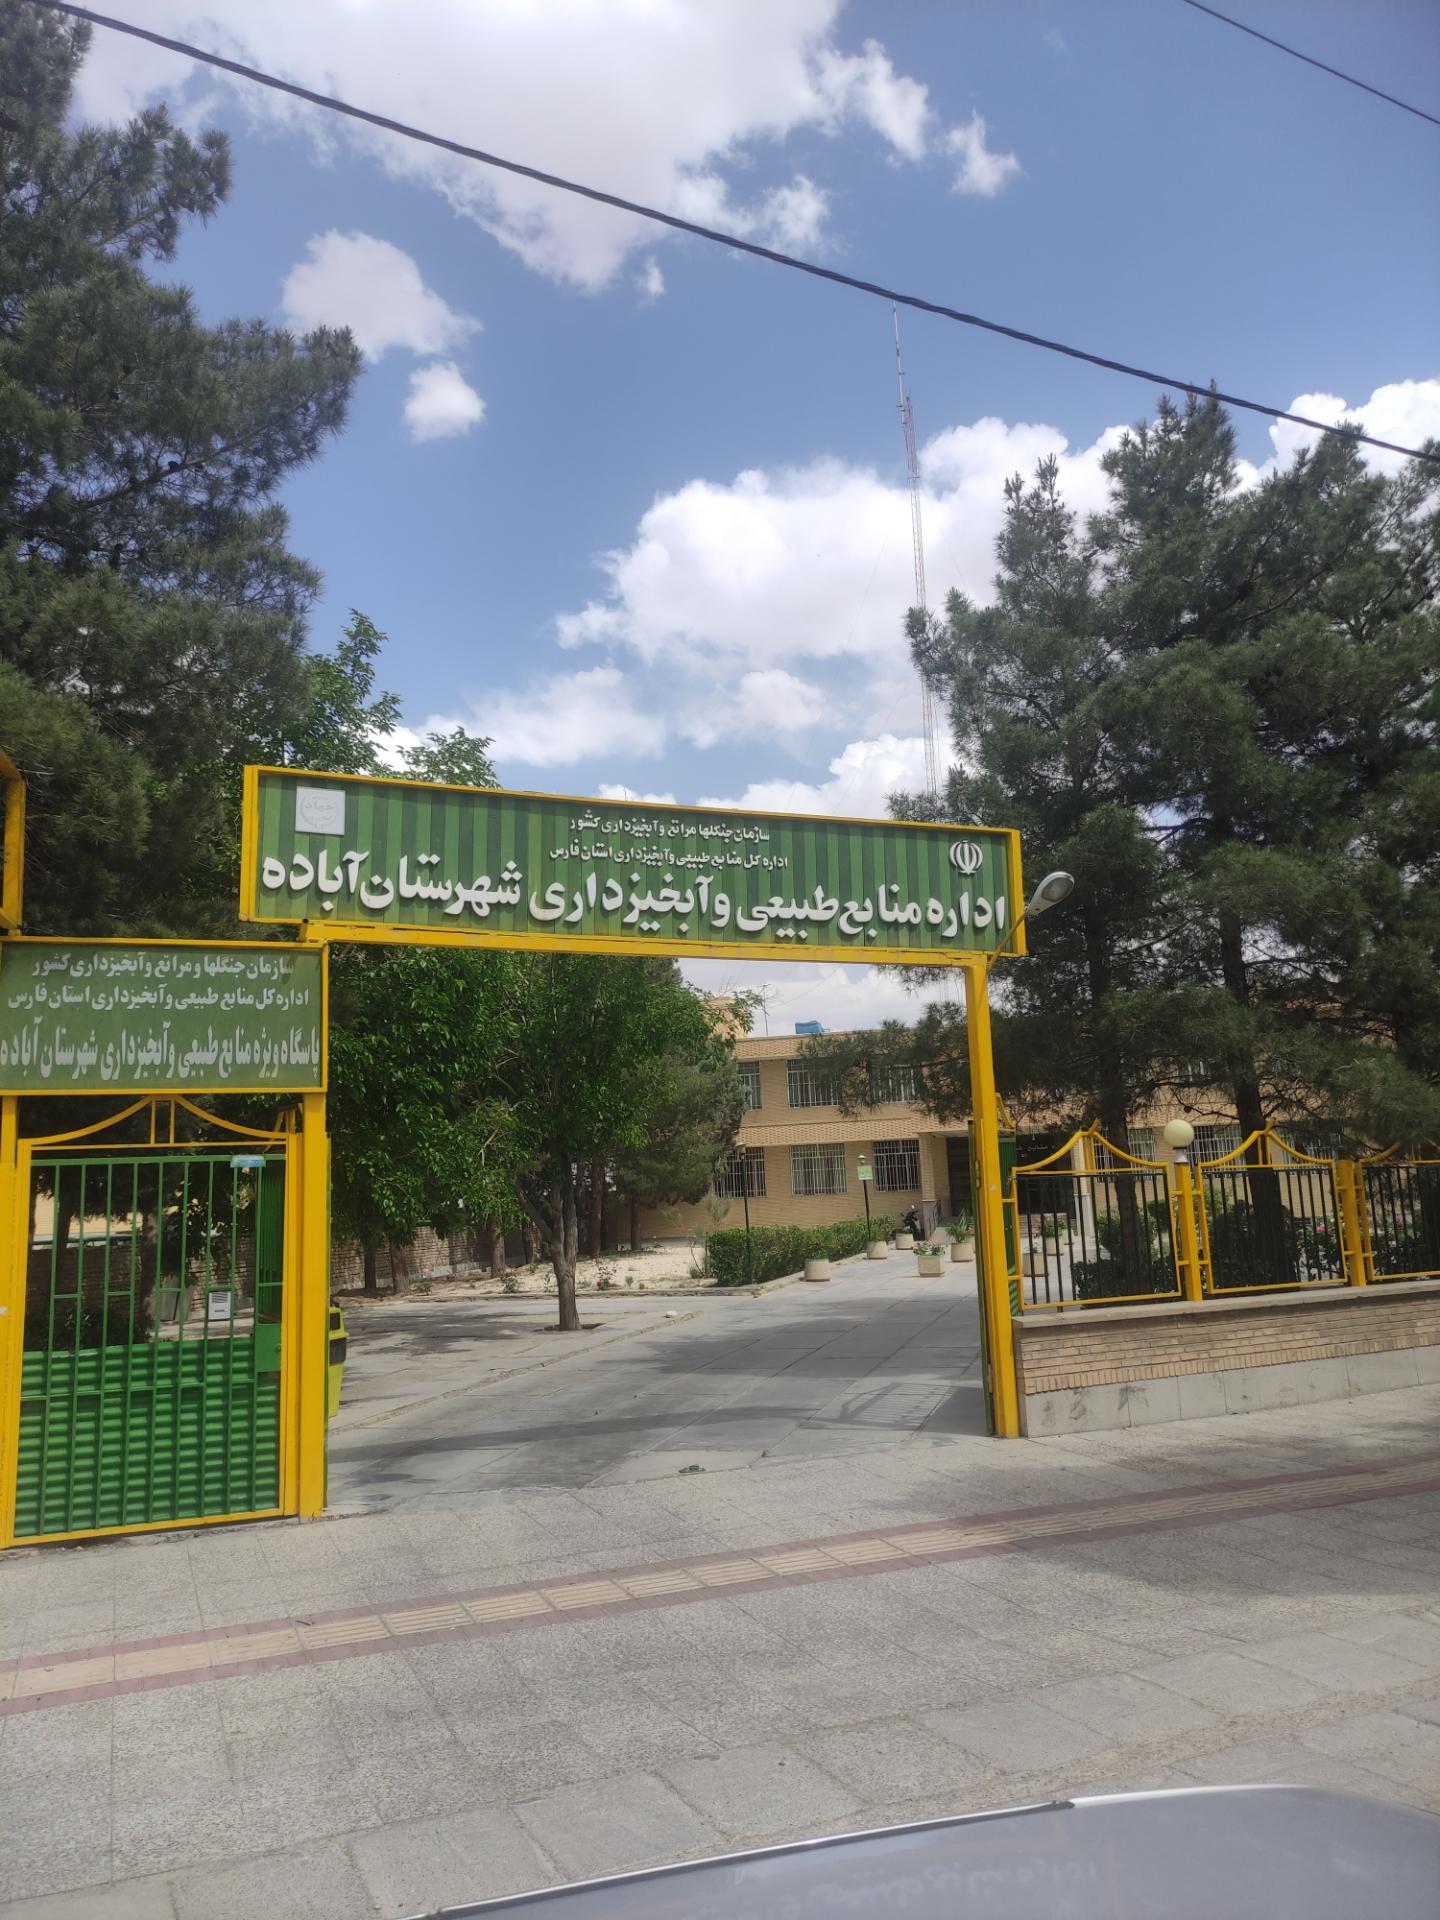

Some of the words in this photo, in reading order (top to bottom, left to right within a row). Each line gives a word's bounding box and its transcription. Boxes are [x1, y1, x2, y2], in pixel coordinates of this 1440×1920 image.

[569, 809, 601, 830] کشور
[667, 819, 697, 838] مراتع
[734, 826, 770, 843] سازمان
[549, 839, 580, 859] فارس
[581, 842, 613, 861] استان
[676, 852, 711, 869] طبیعی
[711, 851, 742, 870] منابع
[743, 854, 762, 869] کل
[762, 856, 788, 871] اداره
[262, 849, 370, 911] آباده
[360, 853, 523, 917] شهرستان
[736, 884, 840, 940] طبیعی
[838, 883, 922, 938] منابع
[927, 891, 1005, 938] اداره
[31, 953, 71, 976] کشور
[154, 955, 192, 978] مراتع
[204, 955, 246, 979] جنگلها
[247, 956, 295, 980] سازمان
[8, 982, 48, 1009] فارس
[48, 985, 91, 1009] استان
[174, 986, 219, 1010] طبیعی
[220, 986, 255, 1010] منابع
[255, 987, 276, 1010] کل
[276, 988, 309, 1011] اداره
[0, 1015, 43, 1077] آباده
[40, 1023, 98, 1080] شهرستان
[178, 1023, 219, 1078] طبیعی
[219, 1024, 252, 1078] منابع
[253, 1026, 280, 1079] ویژه
[280, 1025, 320, 1079] پاسگاه
